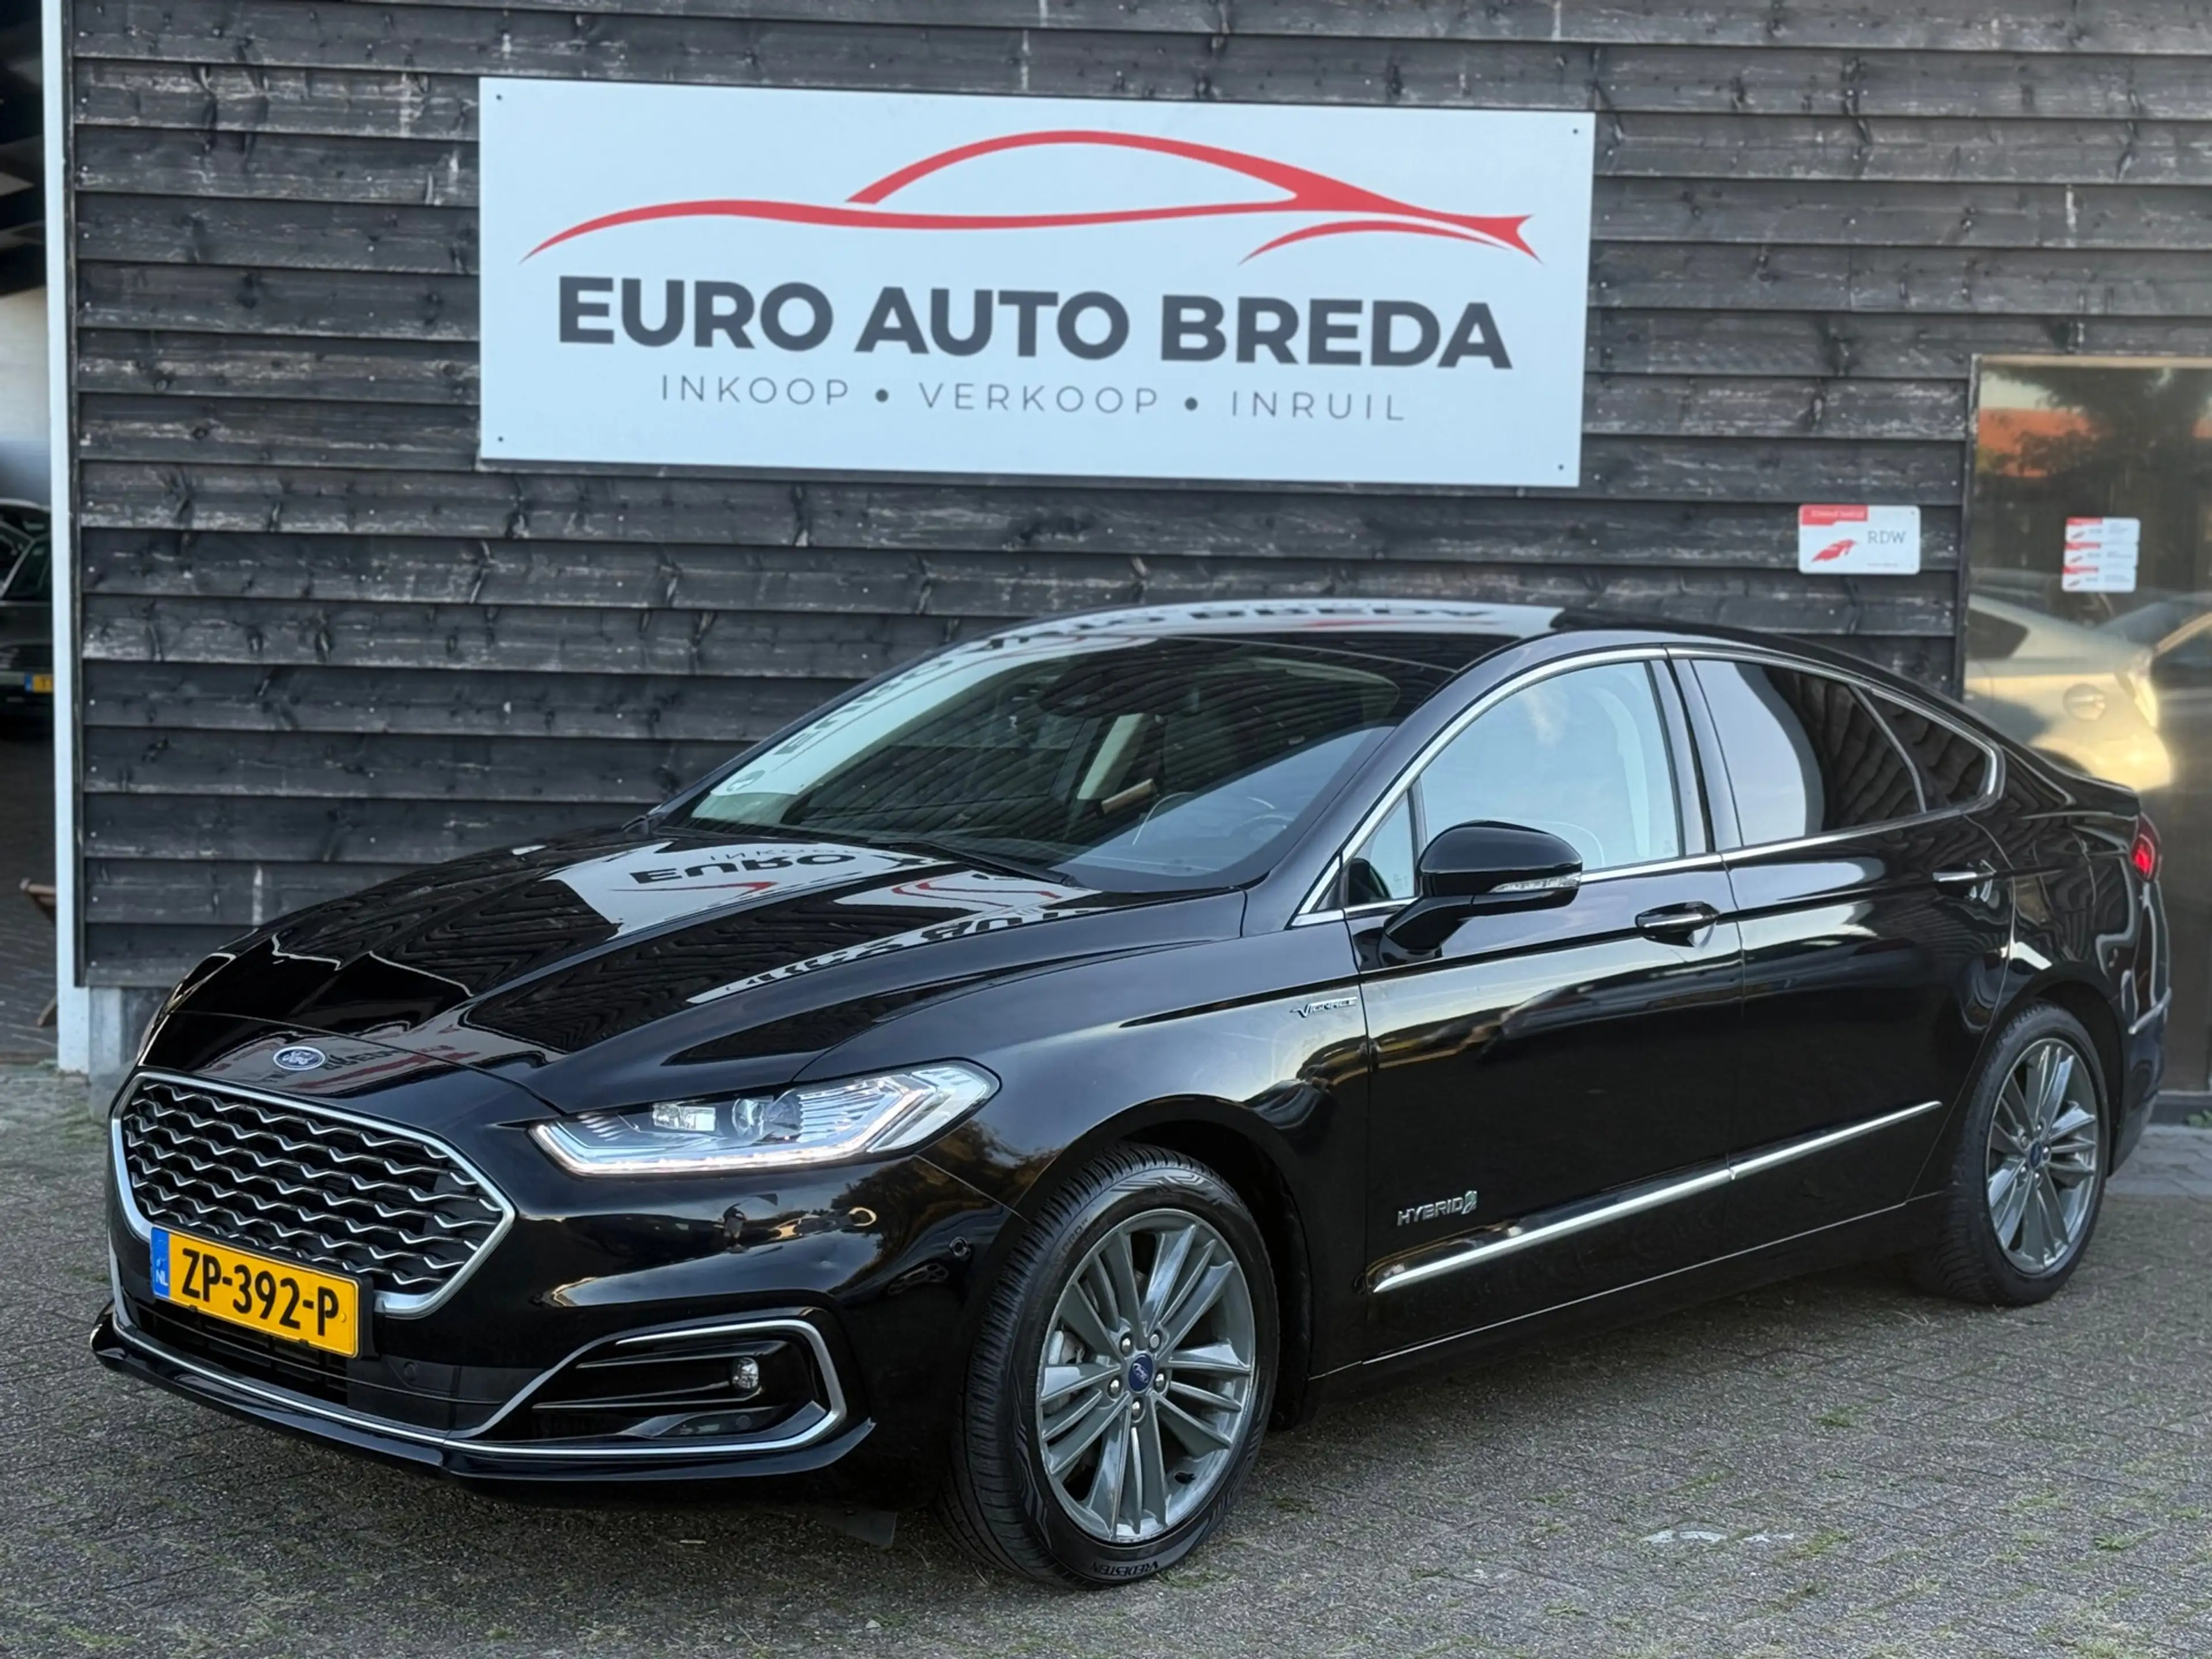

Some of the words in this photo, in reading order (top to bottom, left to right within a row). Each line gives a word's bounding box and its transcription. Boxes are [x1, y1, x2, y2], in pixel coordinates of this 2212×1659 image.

[560, 276, 833, 351] EURO
[855, 287, 1129, 360] AUTO
[1161, 295, 1512, 369] BREDA
[662, 375, 848, 405] INKOOP
[919, 382, 1157, 413] VERKOOP
[1232, 391, 1404, 420] INRUIL
[1868, 531, 1906, 544] RDW
[1397, 1197, 1464, 1226] HYBRID
[156, 1268, 169, 1287] NL
[182, 1248, 339, 1336] ZP-392-P
